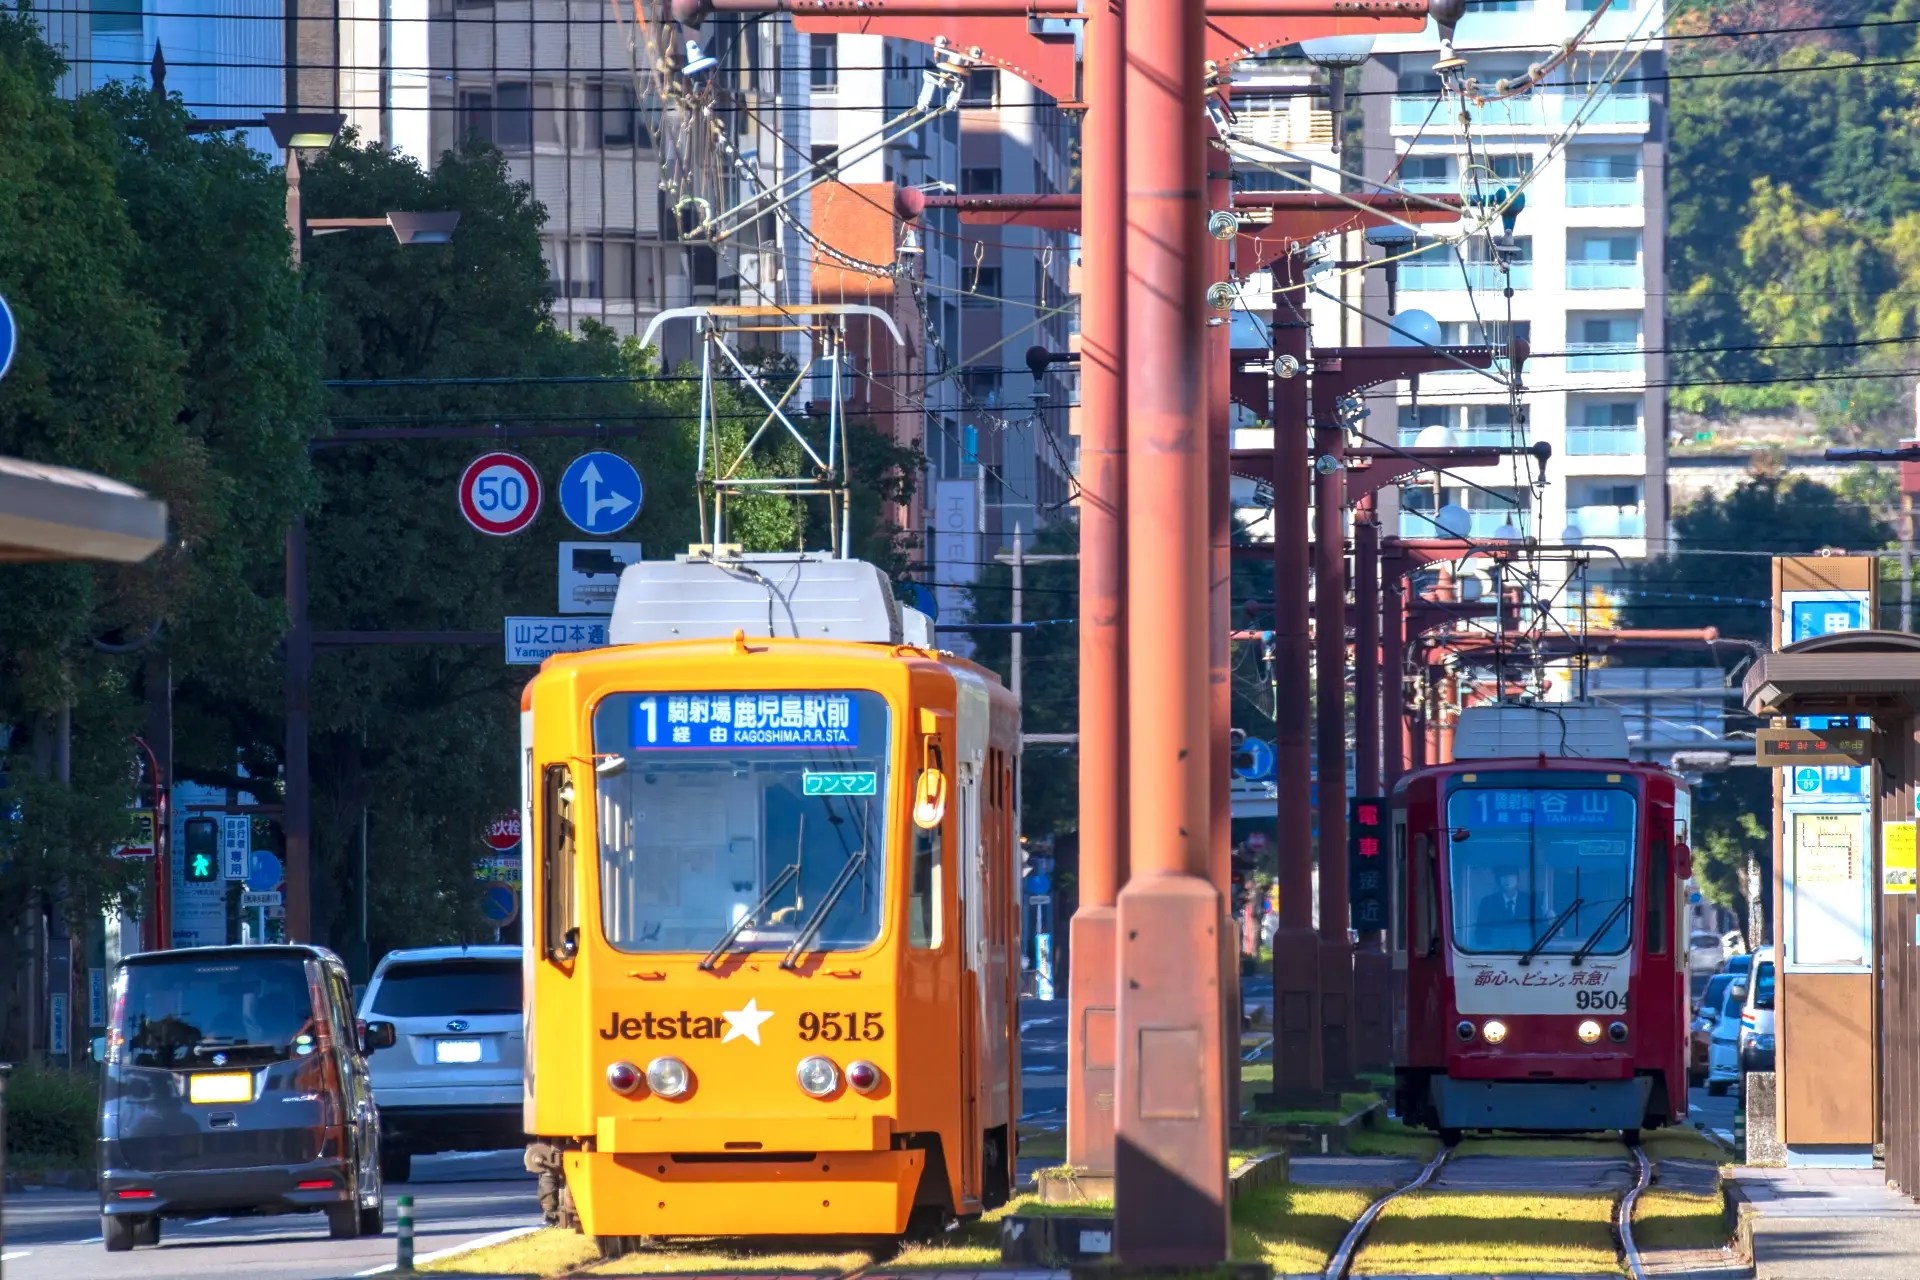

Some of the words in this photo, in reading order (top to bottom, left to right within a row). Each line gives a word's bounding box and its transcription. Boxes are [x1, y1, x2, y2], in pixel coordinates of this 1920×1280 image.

[478, 476, 522, 511] 50
[948, 497, 965, 571] HOTEL
[515, 624, 604, 644] 山之口本通
[640, 698, 657, 743] 1
[668, 696, 731, 724] 騎射場
[734, 694, 850, 728] 鹿児島駅前
[807, 775, 873, 793] ワンマン
[1803, 781, 1814, 789] 09
[1476, 793, 1487, 823] 1
[1540, 791, 1609, 813] 谷山
[1546, 814, 1605, 823] TANIYAMA
[1576, 990, 1630, 1010] 9504
[600, 1010, 726, 1041] Jetstar
[798, 1011, 885, 1042] 9515
